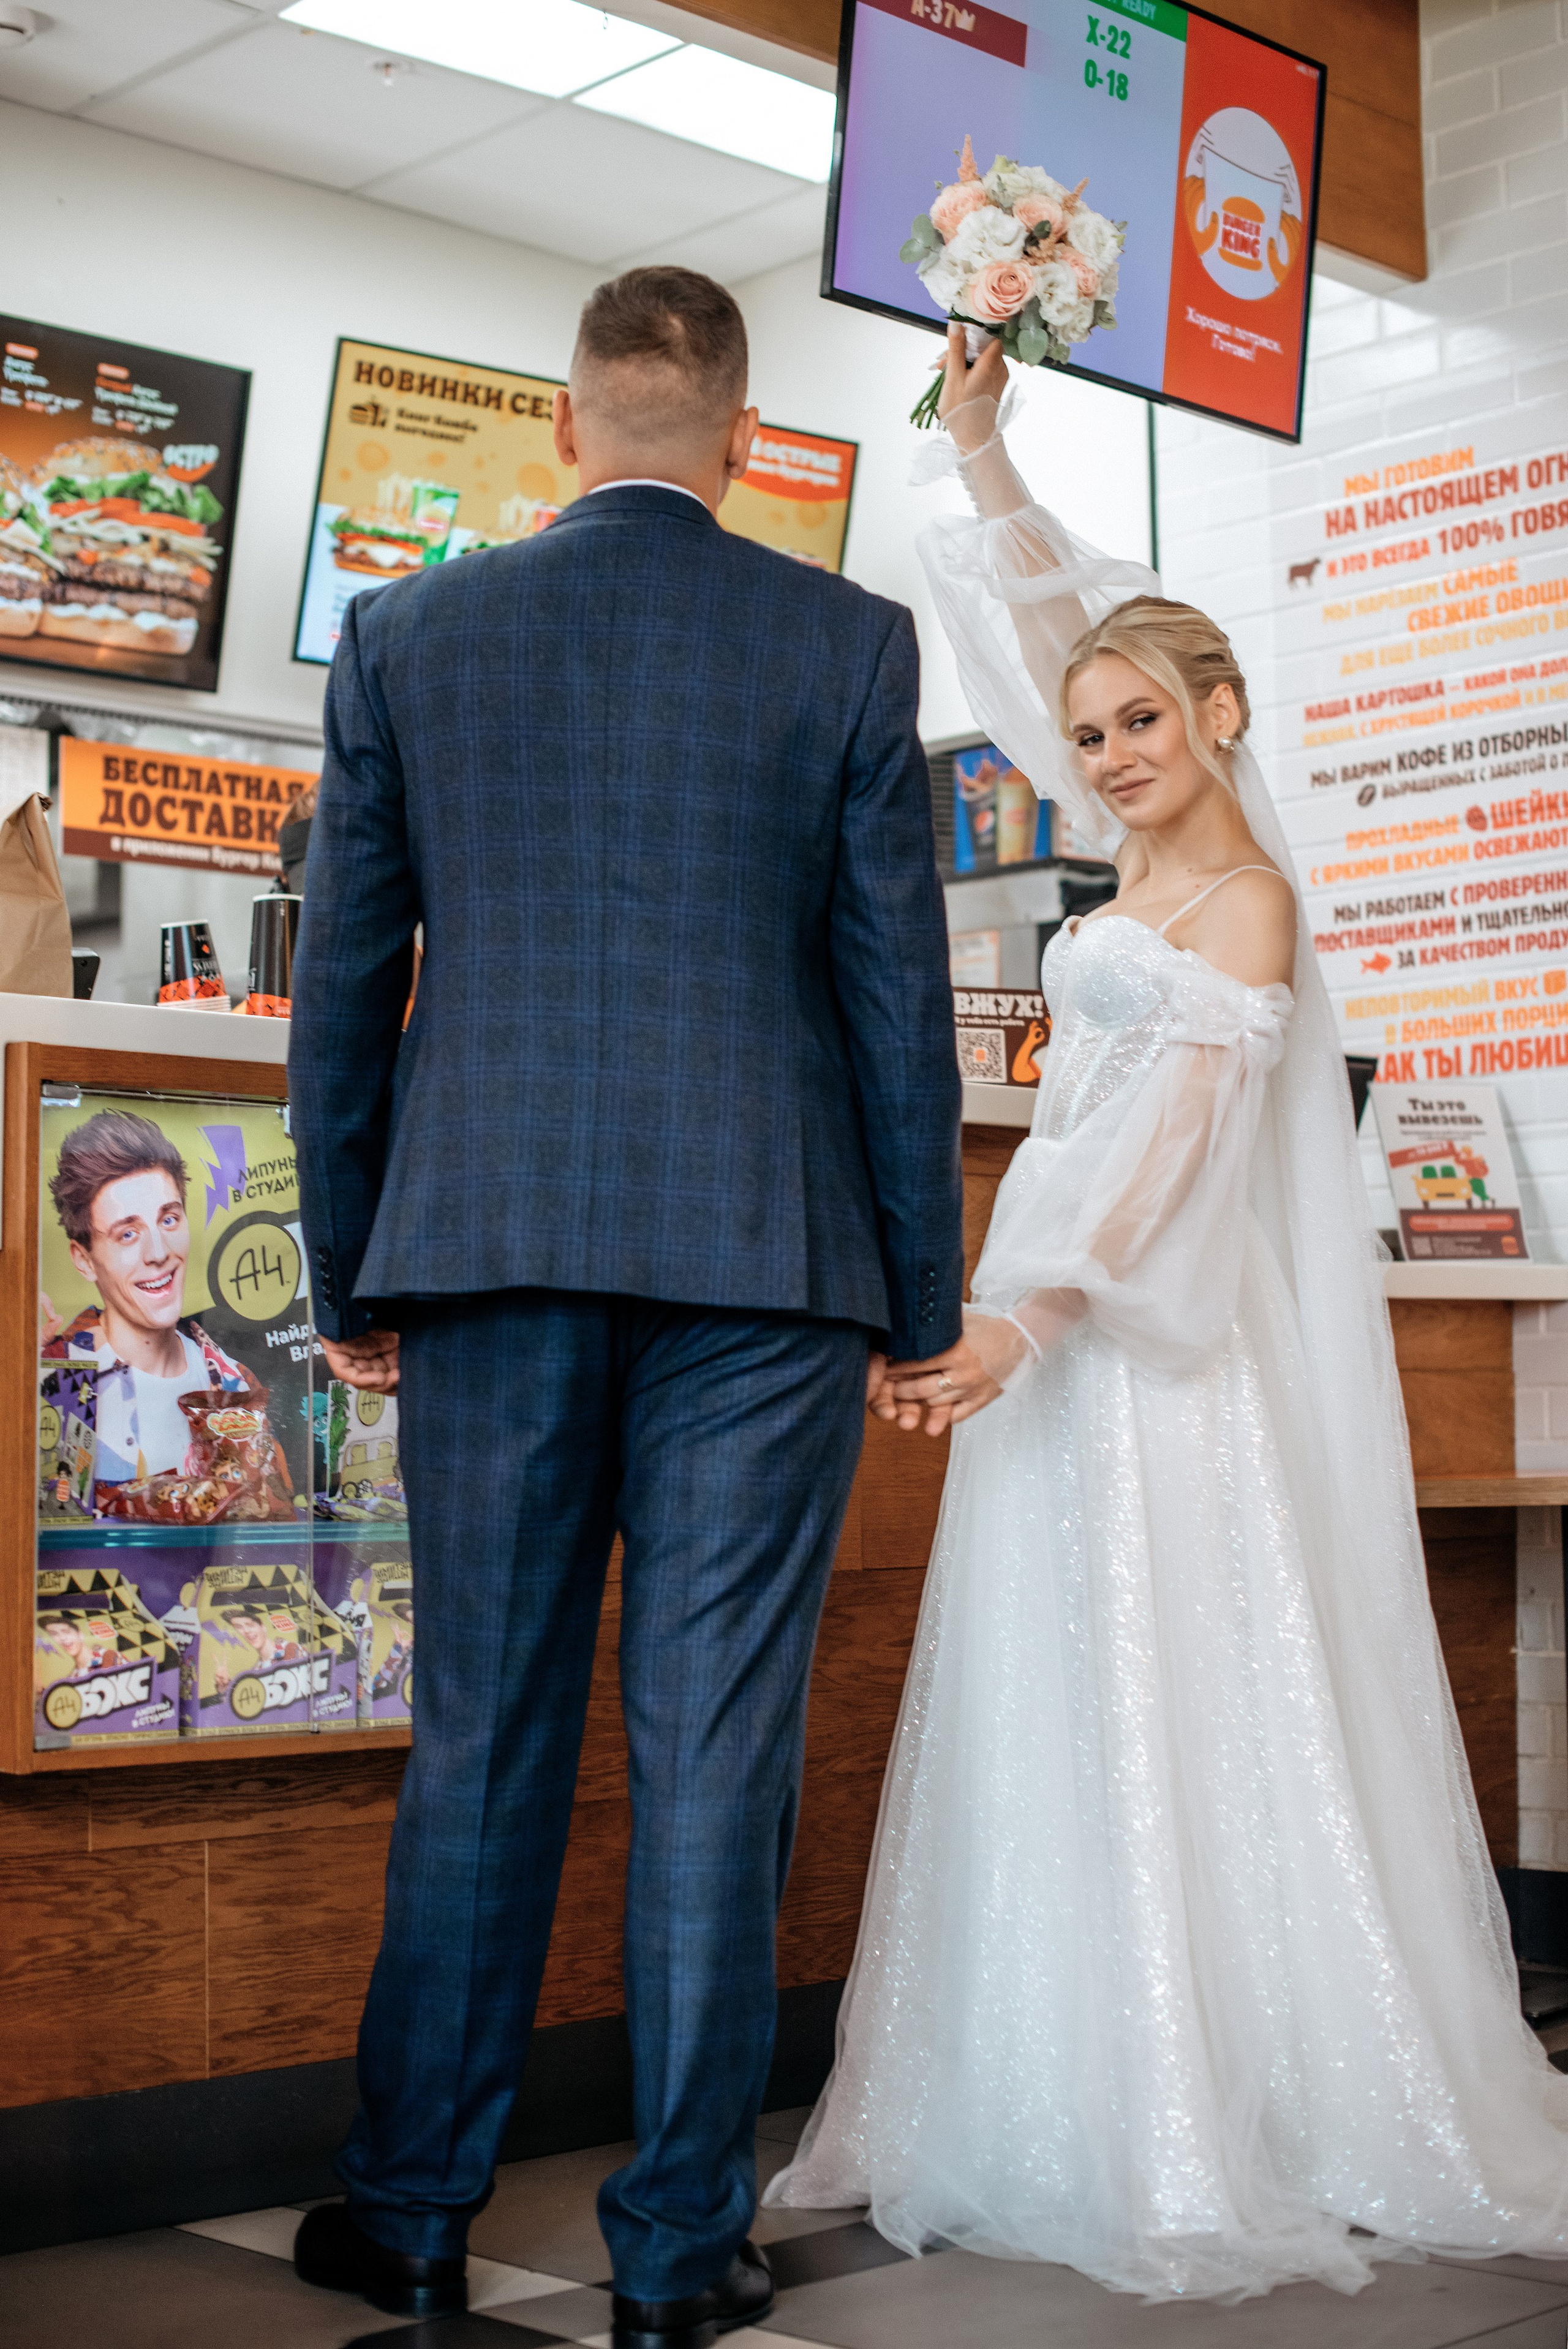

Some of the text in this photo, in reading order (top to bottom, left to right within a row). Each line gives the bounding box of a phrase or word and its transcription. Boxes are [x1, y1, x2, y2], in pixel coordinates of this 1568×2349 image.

[1221, 227, 1260, 259] KING
[354, 360, 504, 411] НОВИНКИ
[1325, 505, 1358, 539] НА
[1365, 464, 1520, 529] НАСТОЯЩЕМ
[1437, 516, 1504, 554] 100%
[1442, 558, 1519, 596] САМЫЕ
[1406, 595, 1490, 633] СВЕЖИЕ
[1355, 679, 1445, 713] КАРТОШКА
[102, 754, 304, 804] БЕСПЛАТНАЯ
[1310, 768, 1336, 789] МЫ
[1340, 757, 1392, 783] ВАРИМ
[1396, 743, 1446, 774] КОФЕ
[1452, 739, 1474, 762] ИЗ
[1488, 753, 1547, 782] ЗАБОТОЙ
[1393, 843, 1469, 873] ВКУСАМИ
[1333, 903, 1362, 924] МЫ
[1365, 889, 1446, 919] РАБОТАЕМ
[1449, 886, 1458, 907] С
[1313, 916, 1456, 953] ПОСТАВЩИКАМИ
[1461, 914, 1472, 935] И
[1398, 949, 1415, 970] ЗА
[1419, 936, 1511, 967] КАЧЕСТВОМ
[953, 992, 1044, 1018] ВЖУХ!
[1494, 976, 1539, 1002] ВКУС
[1401, 1010, 1498, 1044] БОЛЬШИХ
[1374, 1050, 1417, 1084] АК
[1422, 1046, 1462, 1080] ТЫ
[1398, 1114, 1483, 1125] вывезешь
[1408, 1098, 1466, 1111] Ты это
[233, 1189, 242, 1203] В
